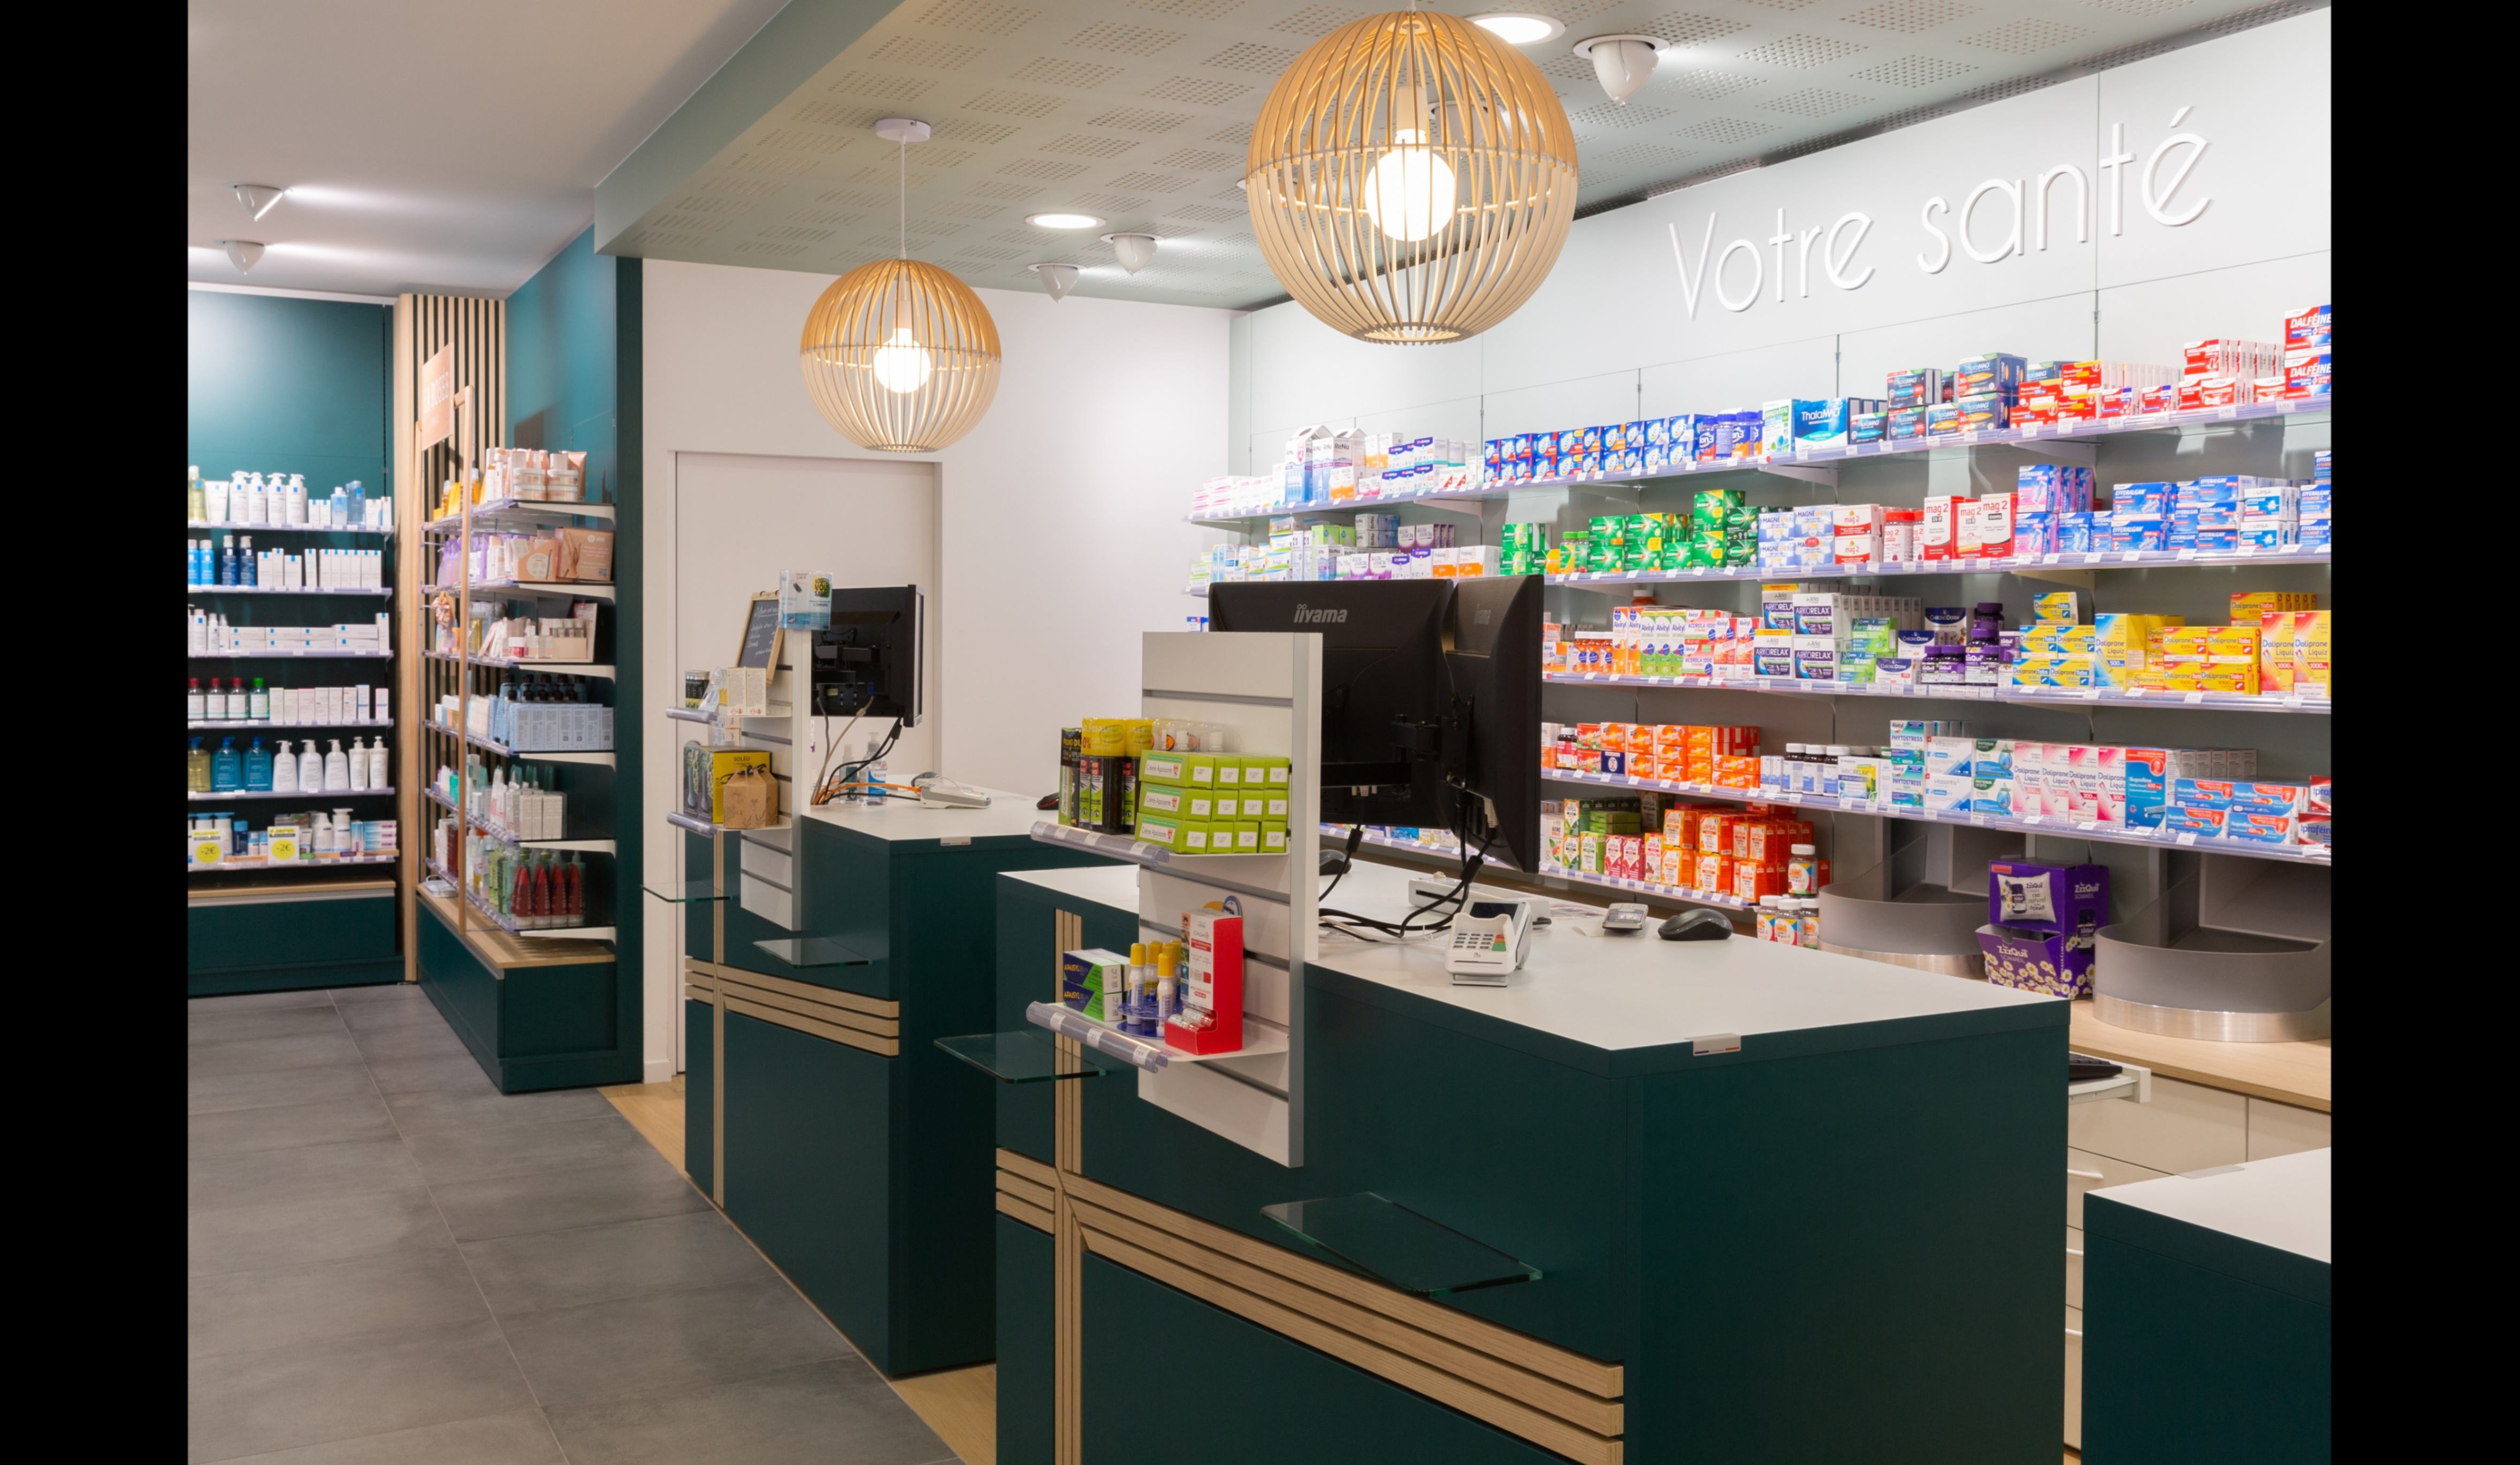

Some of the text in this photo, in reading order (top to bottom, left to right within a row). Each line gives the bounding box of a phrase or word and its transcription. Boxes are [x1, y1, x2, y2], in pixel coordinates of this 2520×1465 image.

[1668, 105, 2213, 320] Votre santé
[2290, 313, 2331, 328] DALFÉINE
[2290, 363, 2331, 378] DALFÉINE
[1801, 408, 1841, 421] ThalaMAG
[1926, 503, 1949, 516] mag 2
[1983, 501, 2007, 512] mag 2
[1960, 507, 1981, 518] mag 2
[1294, 604, 1348, 624] iiyama
[1614, 621, 1626, 630] Alvityl
[1641, 624, 1654, 633] Alvityl
[1656, 624, 1670, 633] Alvityl
[1671, 624, 1685, 633] Alvityl
[2096, 639, 2125, 647] Doliprane
[2263, 640, 2294, 648] Doliprane
[2295, 639, 2328, 647] Doliprane
[1796, 651, 1831, 659] ARKORELAX
[1157, 765, 1172, 773] Apaisante
[2014, 766, 2040, 776] Doliprane
[2042, 769, 2068, 778] Doliprane
[2070, 771, 2096, 780] Doliprane
[1892, 779, 1922, 787] PHYTOSTRESS
[1156, 797, 1171, 806] Apaisante
[1152, 829, 1166, 837] Apaisante
[2301, 825, 2331, 835] Ipraféin
[201, 847, 216, 855] -2€
[276, 843, 291, 852] -2€
[2074, 883, 2100, 893] ZzzQuil
[1997, 945, 2029, 958] ZzzQuil
[1064, 992, 1080, 1000] APAISYL
